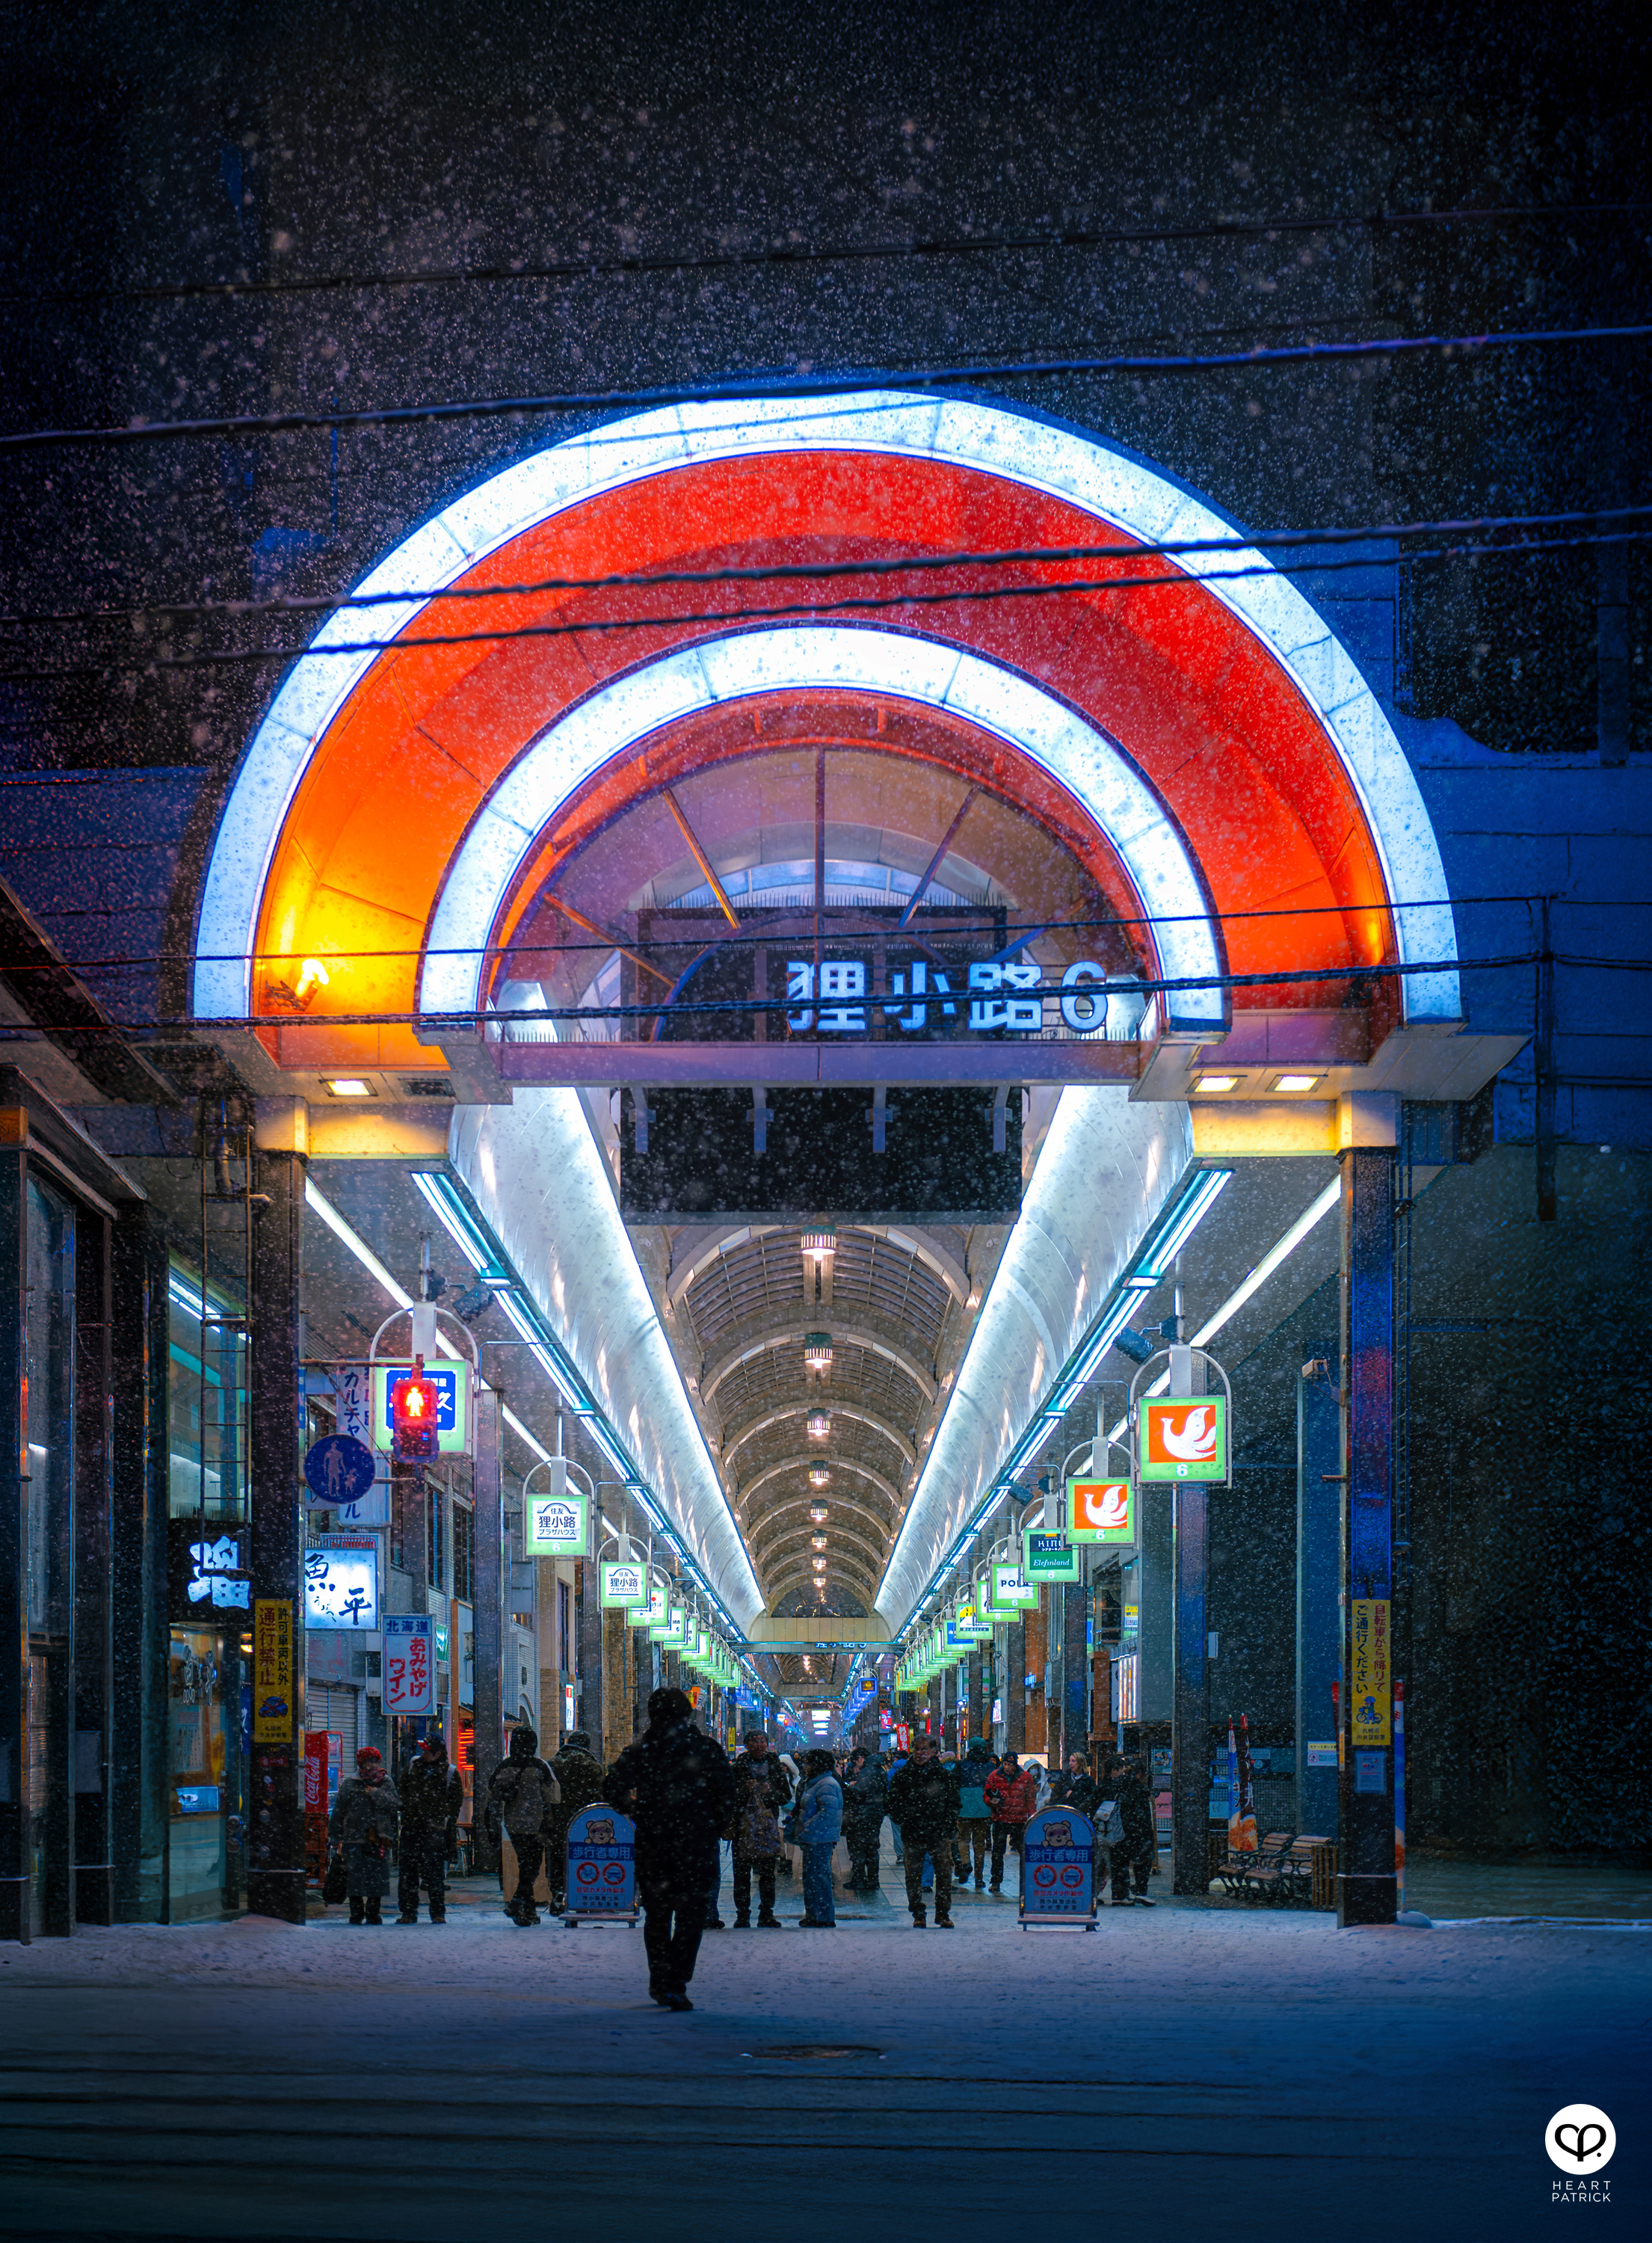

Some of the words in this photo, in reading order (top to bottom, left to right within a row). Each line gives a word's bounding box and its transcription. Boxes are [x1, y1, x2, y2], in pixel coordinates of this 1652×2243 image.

[787, 961, 1108, 1033] 狸小路6
[1176, 1463, 1188, 1477] 6
[539, 1516, 576, 1528] 狸小路
[1096, 1530, 1105, 1539] 6
[552, 1542, 561, 1552] 6
[1033, 1559, 1070, 1567] Elefinland
[1047, 1570, 1055, 1579] 6
[610, 1578, 638, 1587] 狸小路
[386, 1620, 428, 1633] 北海道
[259, 1607, 276, 1686] 通行禁止
[277, 1607, 289, 1685] 許可車両以外
[1356, 1604, 1368, 1693] ご通行ください
[1374, 1604, 1387, 1693] 自転車から降りて
[410, 1637, 427, 1697] おみやげ
[389, 1658, 406, 1704] ワイン
[304, 1755, 320, 1805] Coca-Cola
[573, 1847, 630, 1859] 歩行者専用
[1029, 1849, 1088, 1862] 歩行者専用
